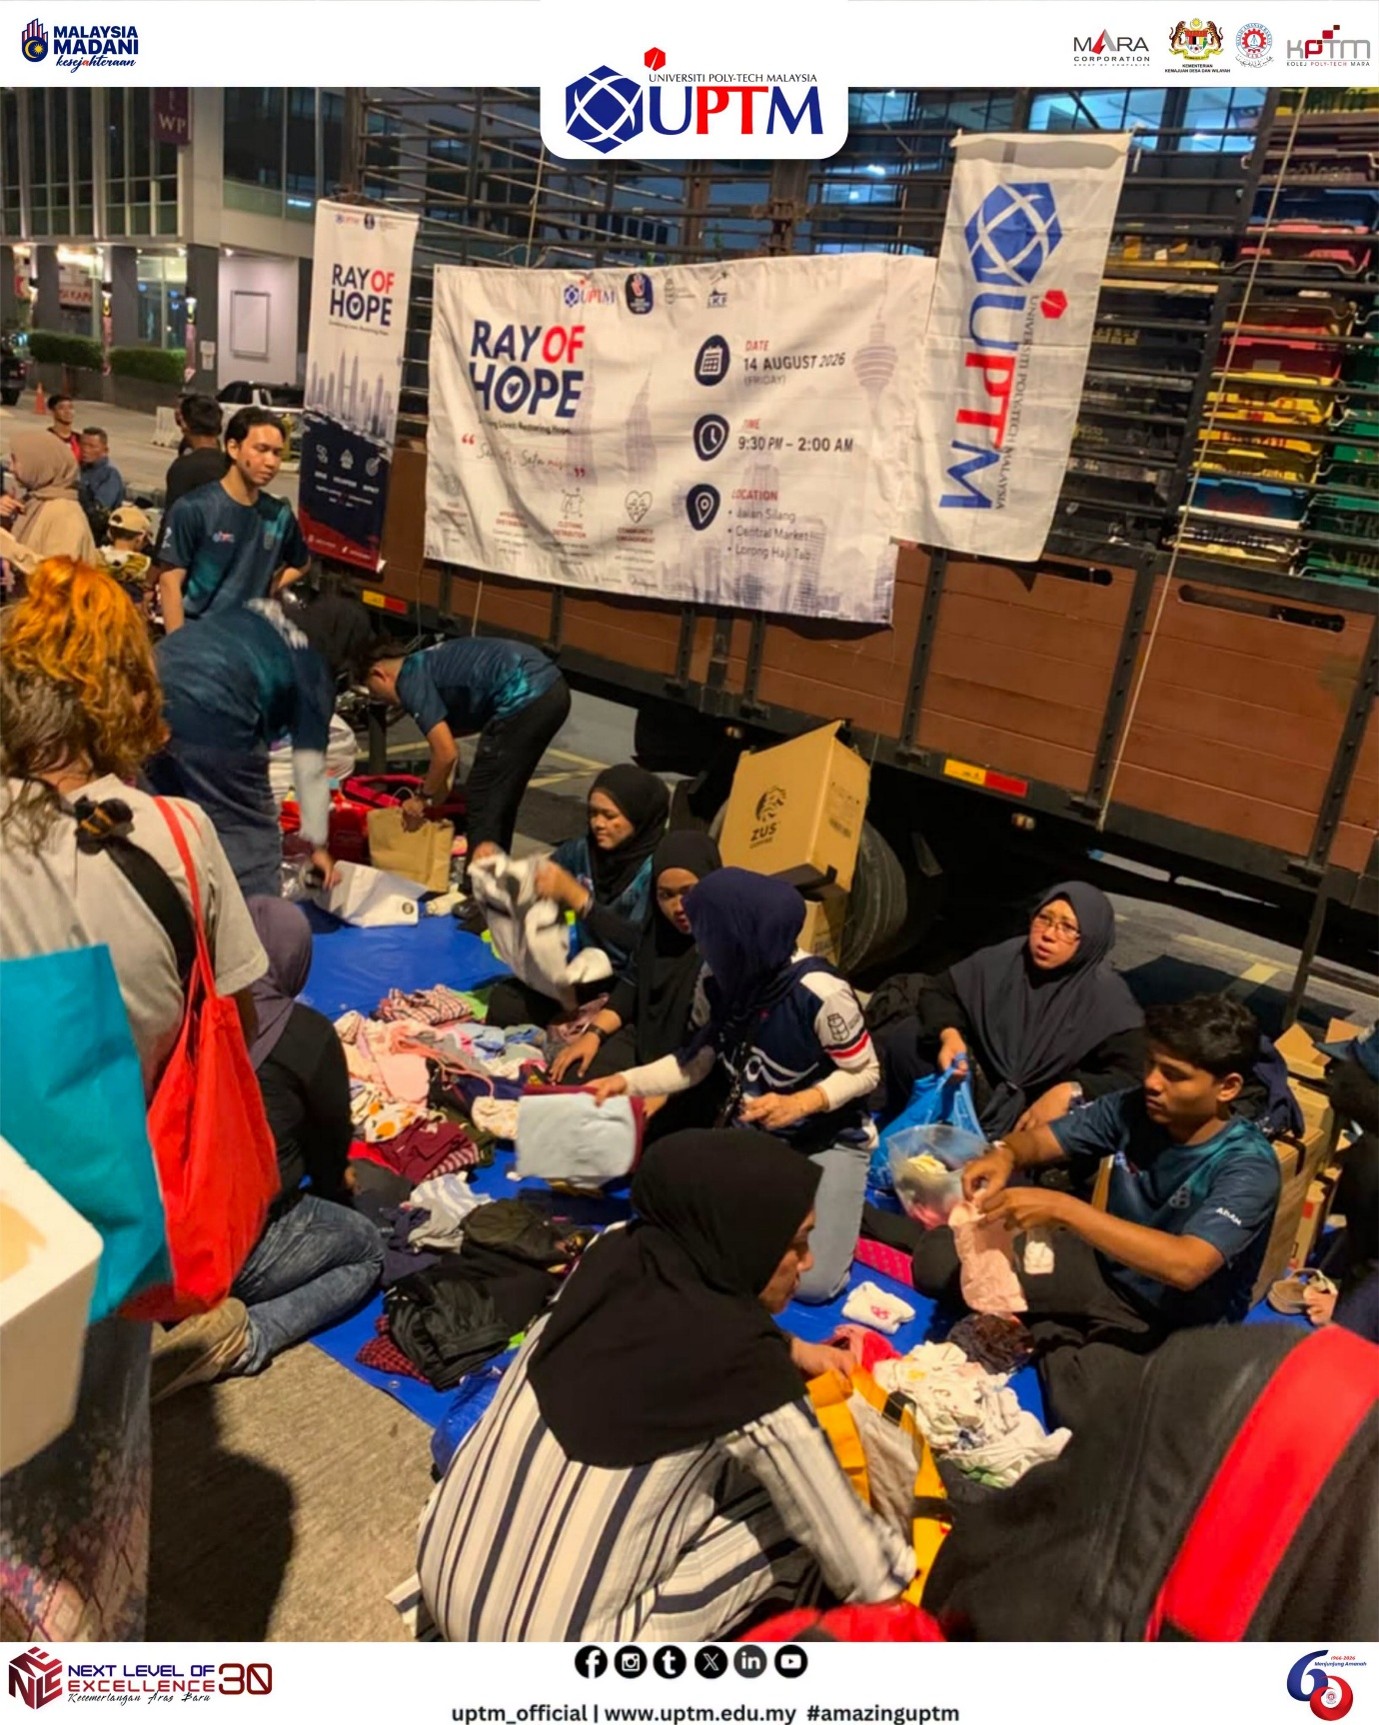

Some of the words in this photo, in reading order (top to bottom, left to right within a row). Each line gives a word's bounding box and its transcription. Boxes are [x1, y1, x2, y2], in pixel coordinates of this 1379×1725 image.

[332, 263, 370, 290] RAY
[370, 269, 395, 294] OF
[330, 289, 393, 327] HOPE
[470, 319, 542, 363] RAY
[541, 325, 586, 364] OF
[1017, 294, 1040, 371] UNIVERSITI
[745, 340, 770, 352] DATE
[744, 357, 757, 371] 14
[763, 355, 817, 371] AUGUST
[819, 352, 846, 368] 2026
[744, 374, 786, 386] (FRIDAY)
[469, 361, 585, 419] HOPE
[939, 291, 1027, 510] UPTM
[743, 419, 761, 430] TIME
[738, 436, 764, 451] 9:30
[767, 437, 784, 451] PM
[798, 437, 830, 451] 2:00
[835, 438, 853, 452] AM
[995, 445, 1015, 510] MALAYSIA
[731, 489, 779, 501] LOCATION
[737, 508, 764, 519] Jalan
[765, 508, 796, 524] Silang
[736, 525, 773, 538] Central
[774, 528, 810, 541] Market
[750, 822, 777, 842] ZUS
